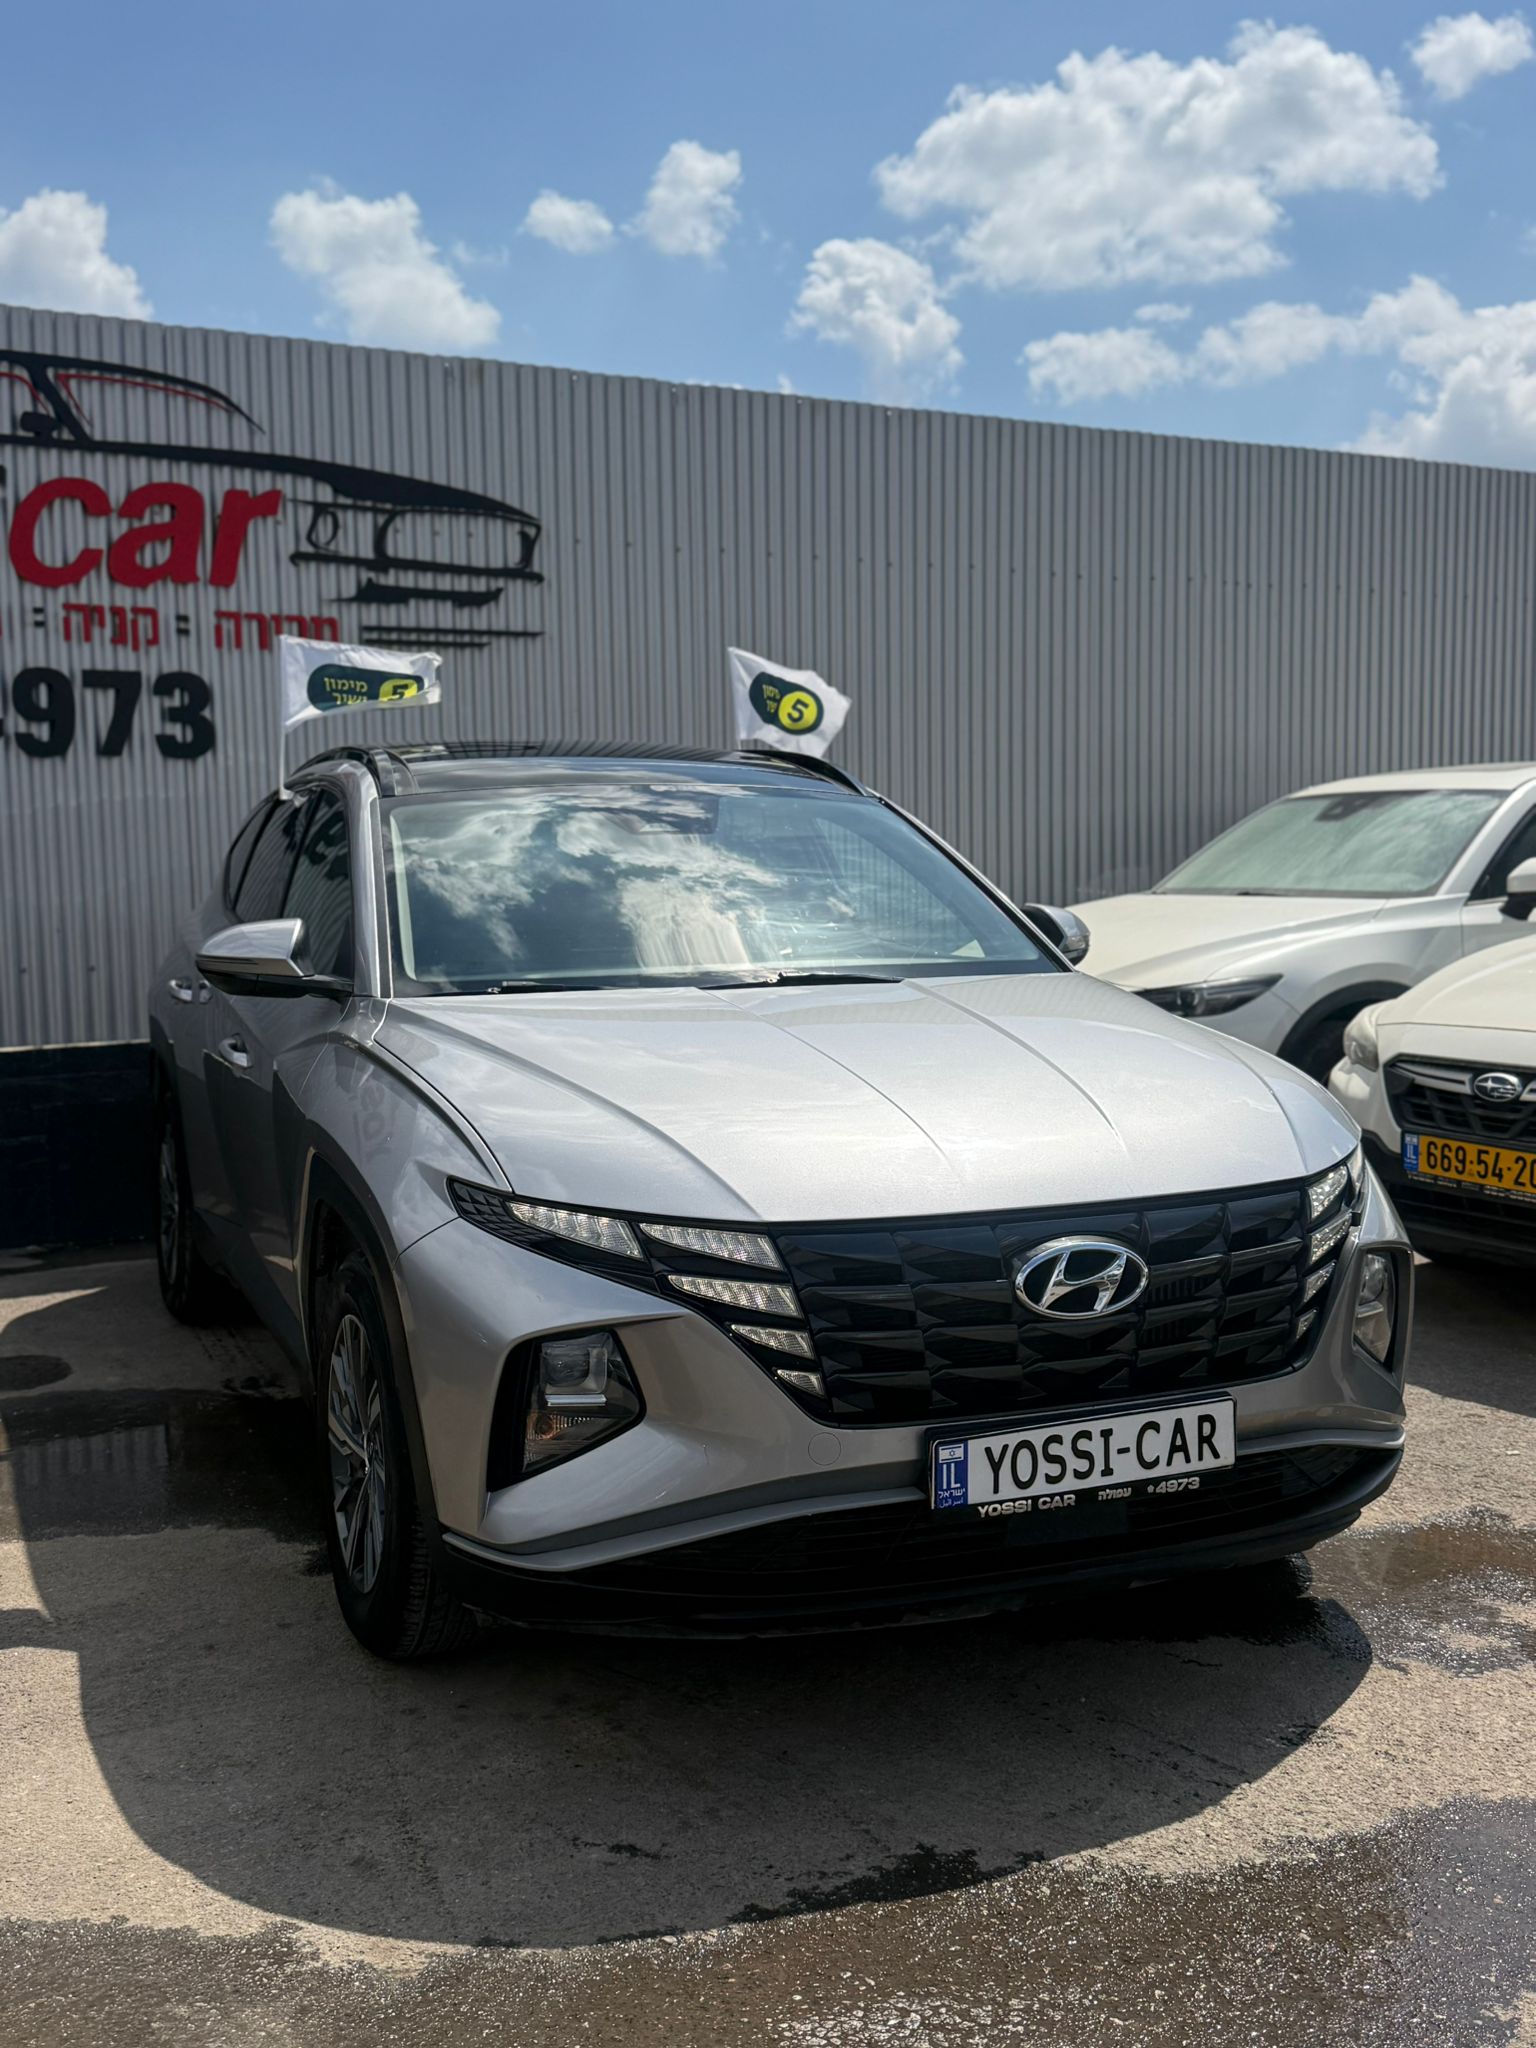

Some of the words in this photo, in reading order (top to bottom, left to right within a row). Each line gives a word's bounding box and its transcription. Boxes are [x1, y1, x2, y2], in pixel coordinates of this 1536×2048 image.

[9, 477, 282, 588] car
[62, 602, 160, 652] קניה
[324, 677, 368, 693] מימון
[0, 667, 216, 760] 973
[787, 698, 809, 723] 5
[984, 1413, 1221, 1495] YOSSI-CAR
[943, 1463, 961, 1489] IL
[938, 1487, 966, 1499] ישראל
[977, 1499, 1032, 1518] YOSSI
[1037, 1494, 1076, 1510] CAR
[1098, 1487, 1132, 1501] עפולה
